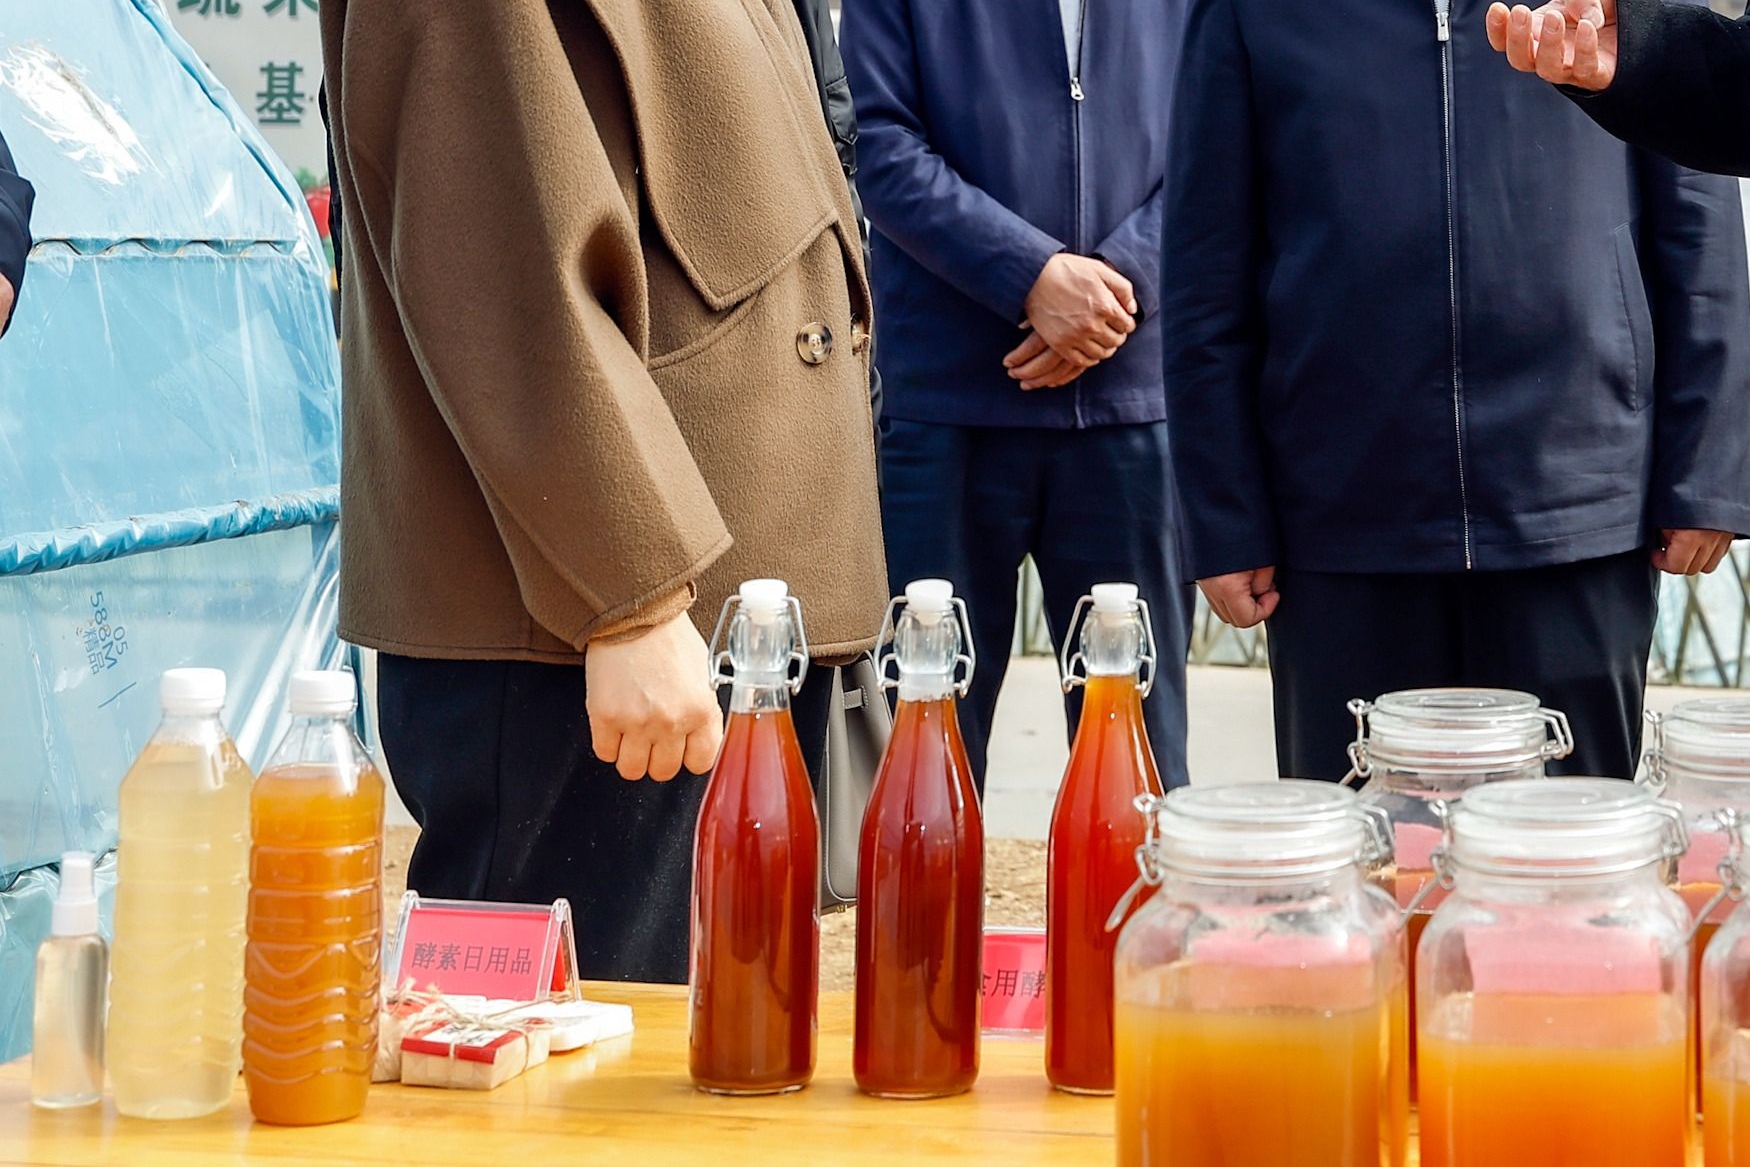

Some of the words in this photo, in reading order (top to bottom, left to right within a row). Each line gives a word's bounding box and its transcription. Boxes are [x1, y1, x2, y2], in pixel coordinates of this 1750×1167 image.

[256, 62, 305, 124] 基
[90, 591, 118, 669] 588M
[411, 942, 532, 975] 酵素日用品
